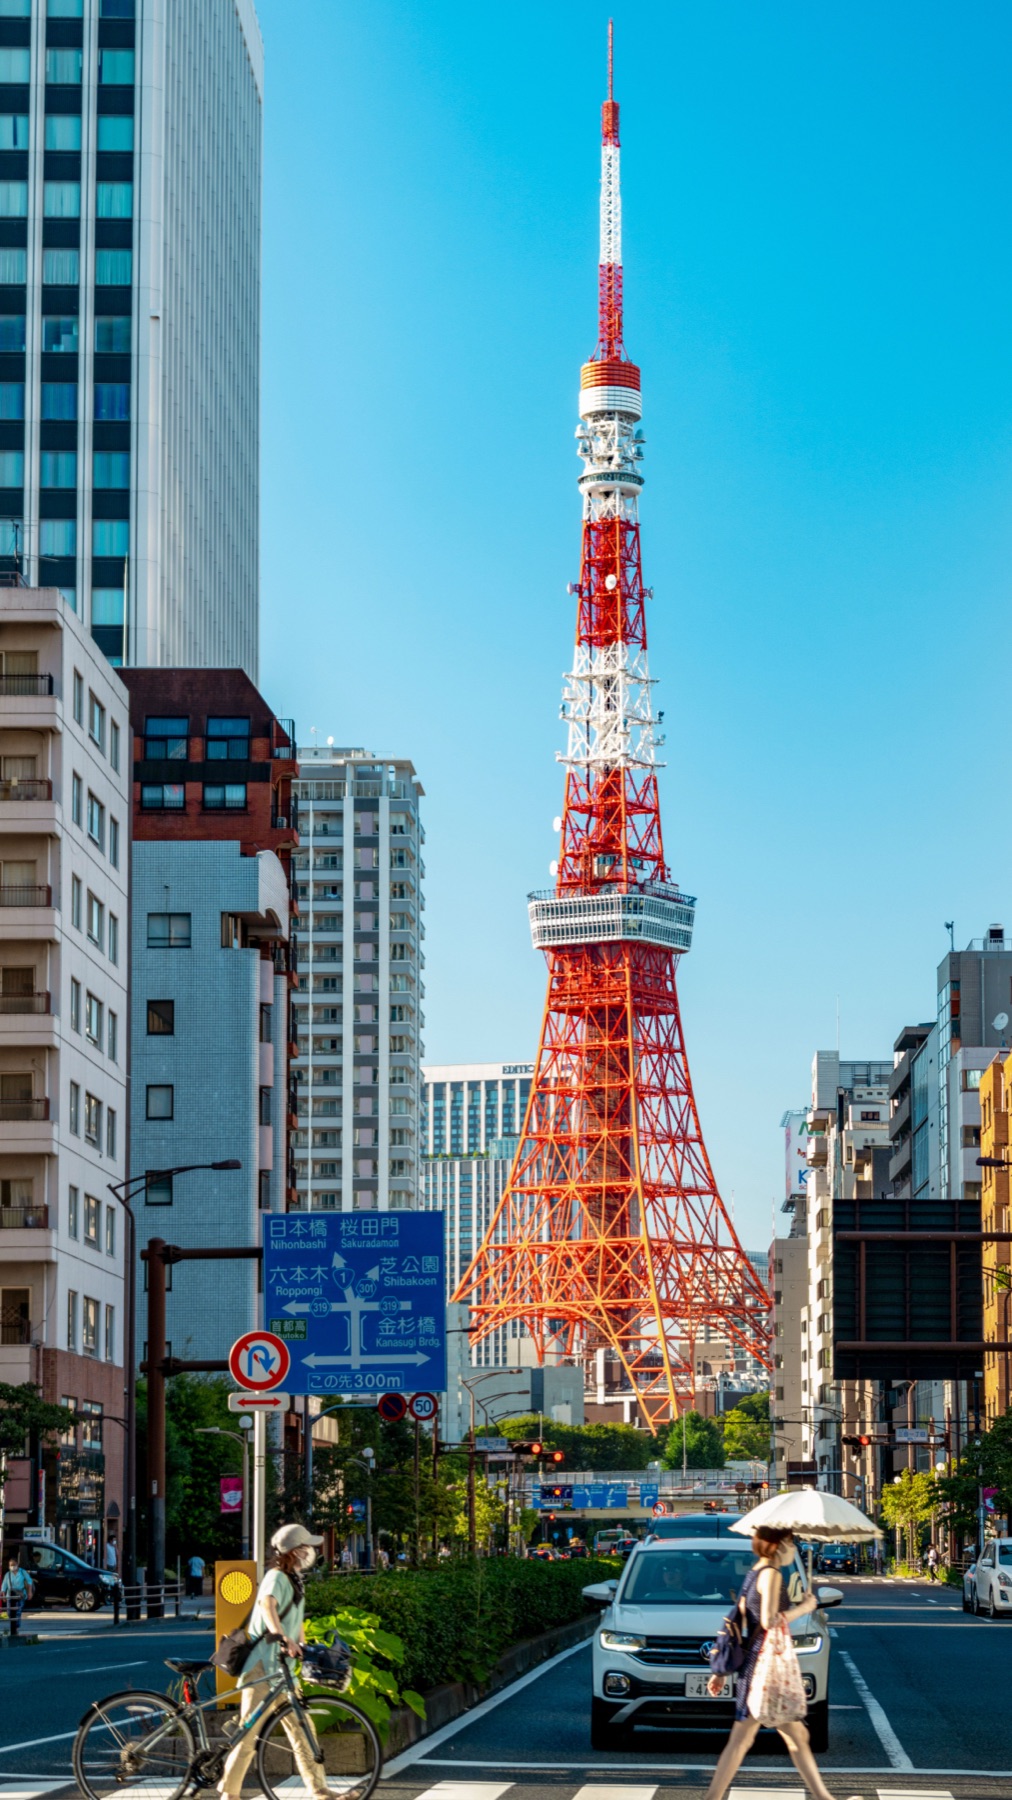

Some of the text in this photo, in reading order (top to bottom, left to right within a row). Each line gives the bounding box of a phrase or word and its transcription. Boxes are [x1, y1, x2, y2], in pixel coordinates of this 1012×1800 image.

[270, 1217, 399, 1237] 日本橋 桜田門
[270, 1239, 399, 1250] Nihonbashi Sakuradamon
[379, 1256, 439, 1275] 芝公園
[269, 1266, 328, 1284] 六本木
[340, 1272, 346, 1283] 1
[383, 1276, 437, 1287] Shibakoen
[275, 1286, 323, 1297] Roppongi
[359, 1283, 374, 1294] 301
[313, 1302, 328, 1313] 319
[382, 1300, 397, 1311] 319
[271, 1321, 306, 1333] 首都高
[378, 1318, 436, 1336] 金杉橋
[376, 1337, 416, 1348] Kanasugi
[310, 1375, 401, 1389] この先300m
[415, 1400, 432, 1413] 50
